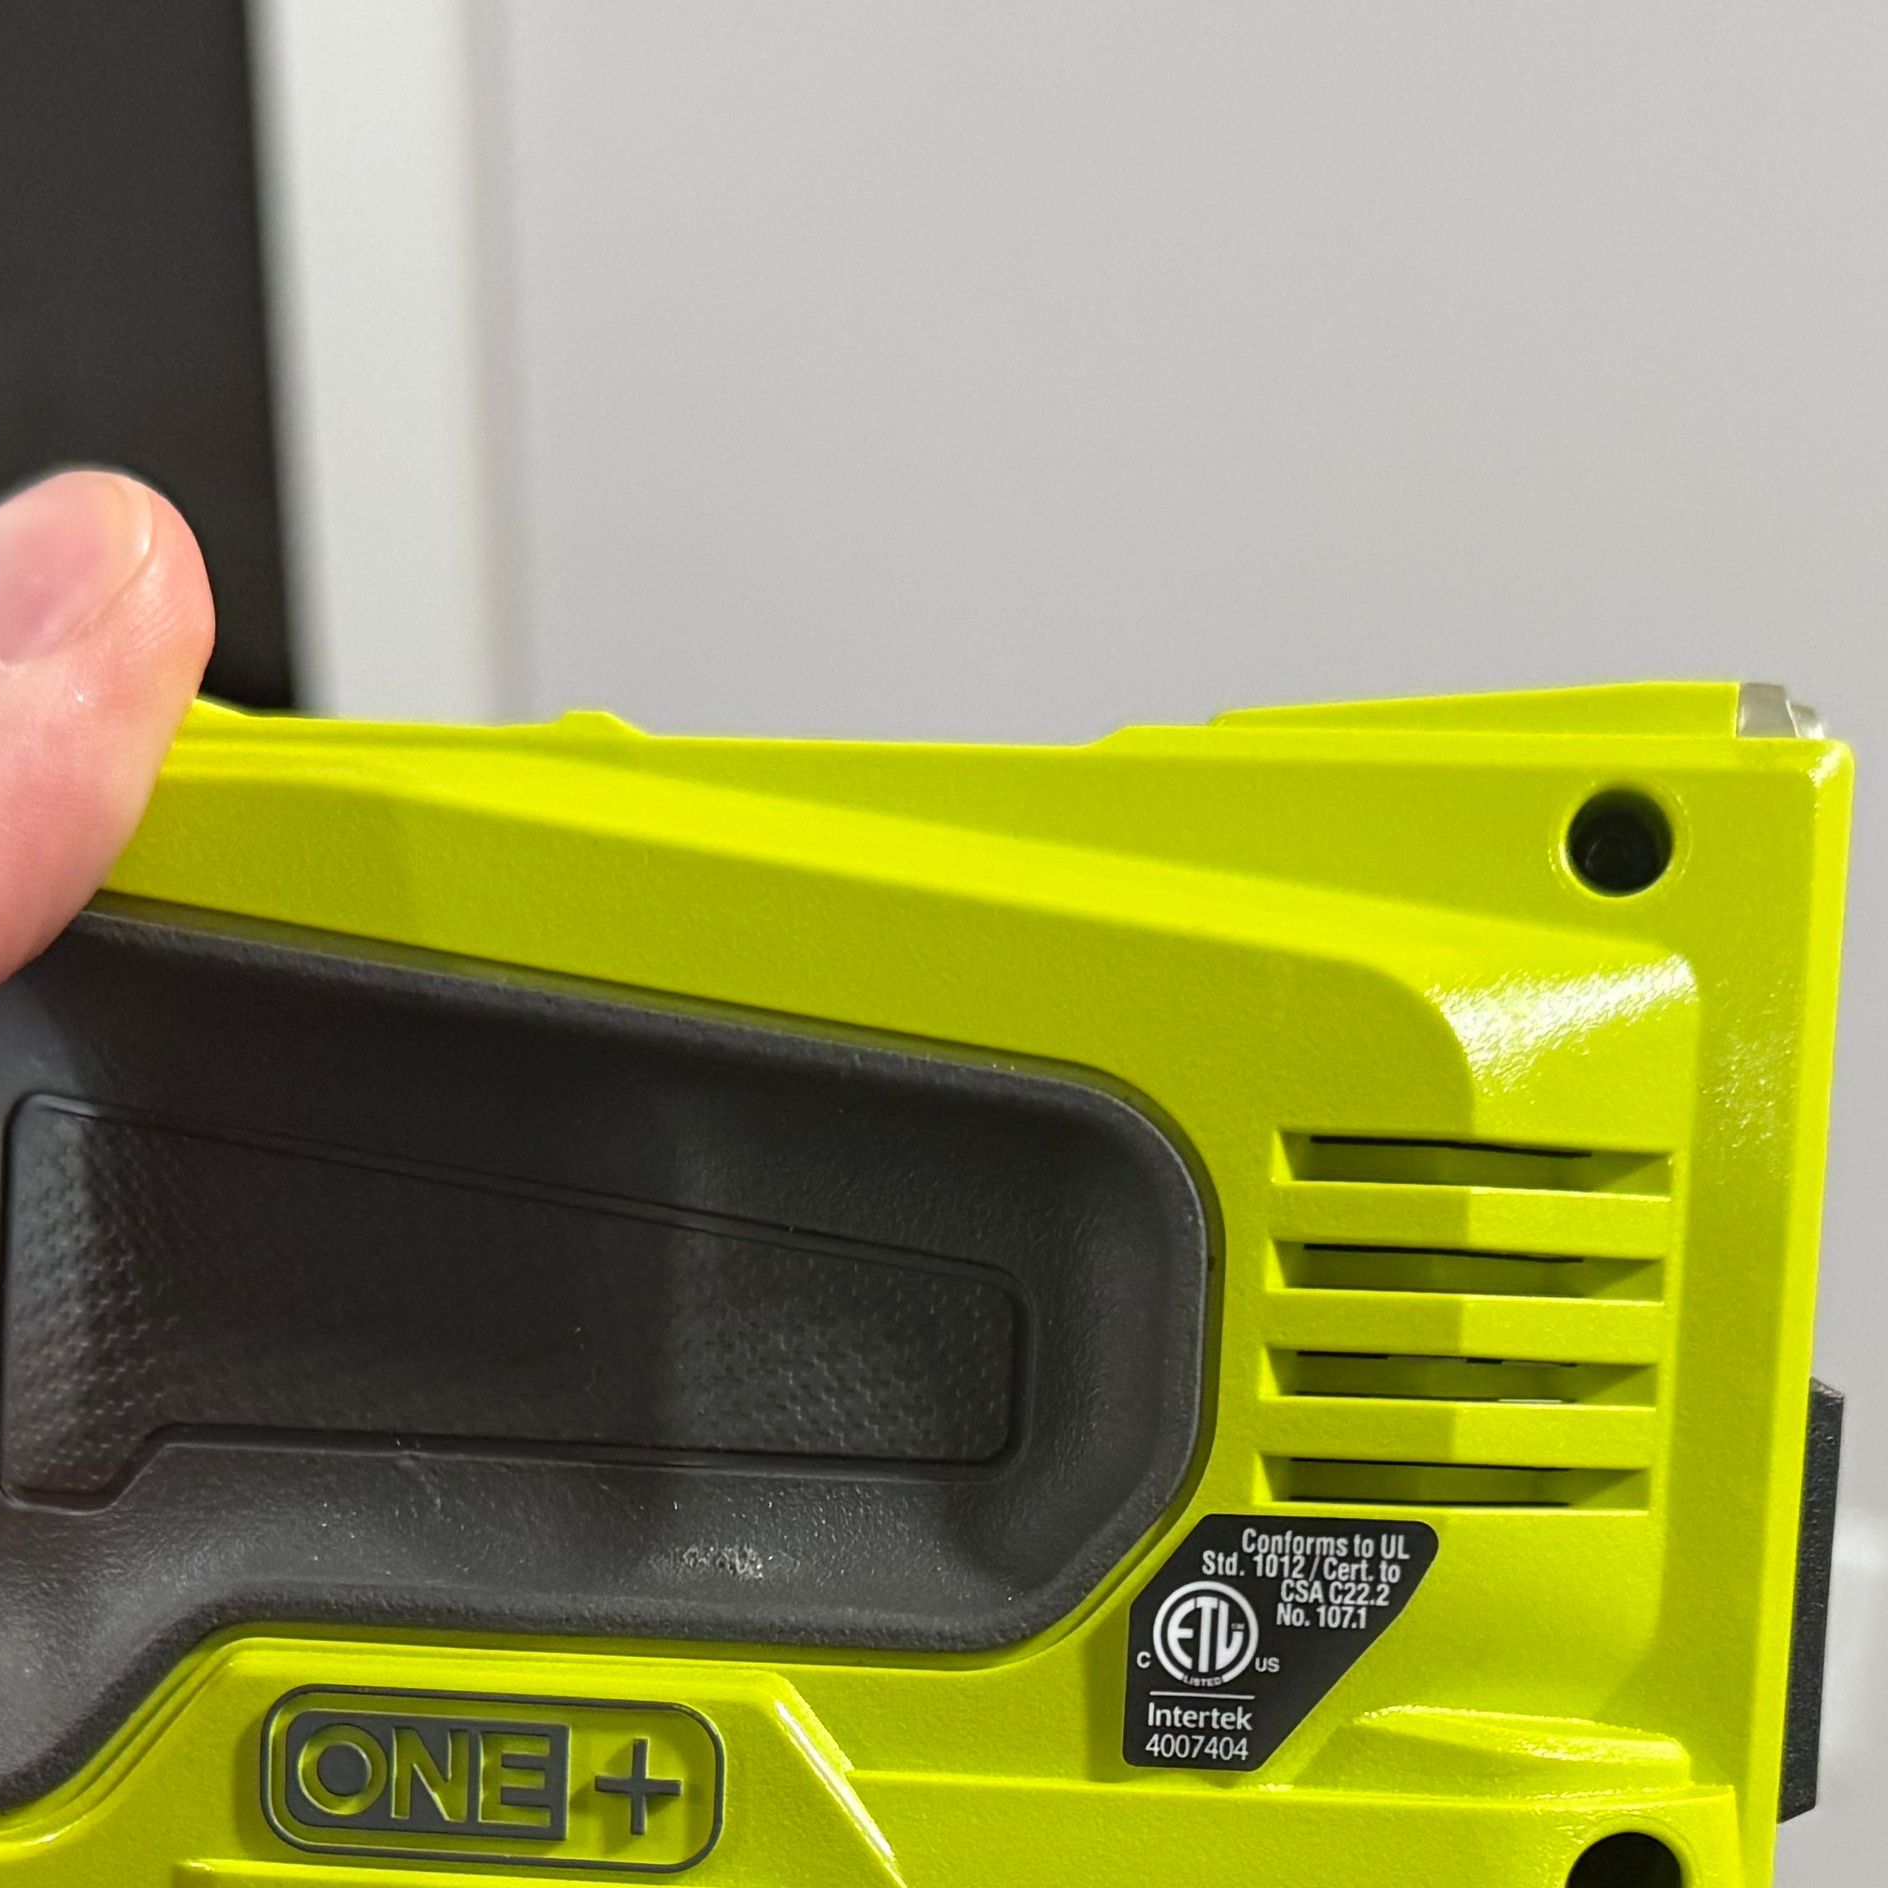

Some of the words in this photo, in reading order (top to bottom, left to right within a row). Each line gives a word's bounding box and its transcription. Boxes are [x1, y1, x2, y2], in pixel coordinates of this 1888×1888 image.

[1242, 1528, 1348, 1555] Conforms
[1353, 1533, 1374, 1558] to
[1380, 1534, 1410, 1560] UL
[1202, 1550, 1245, 1577] Std.
[1253, 1553, 1305, 1579] 1012
[1380, 1560, 1400, 1583] to
[1280, 1579, 1323, 1604] CSA
[1329, 1582, 1390, 1607] C22.2
[1276, 1602, 1310, 1627] No.
[1318, 1606, 1366, 1629] 107.1
[1167, 1596, 1244, 1673] ETL
[1255, 1657, 1280, 1673] US
[1182, 1675, 1223, 1687] LISTED
[1148, 1702, 1253, 1731] Intertek
[1145, 1733, 1249, 1761] 4007404
